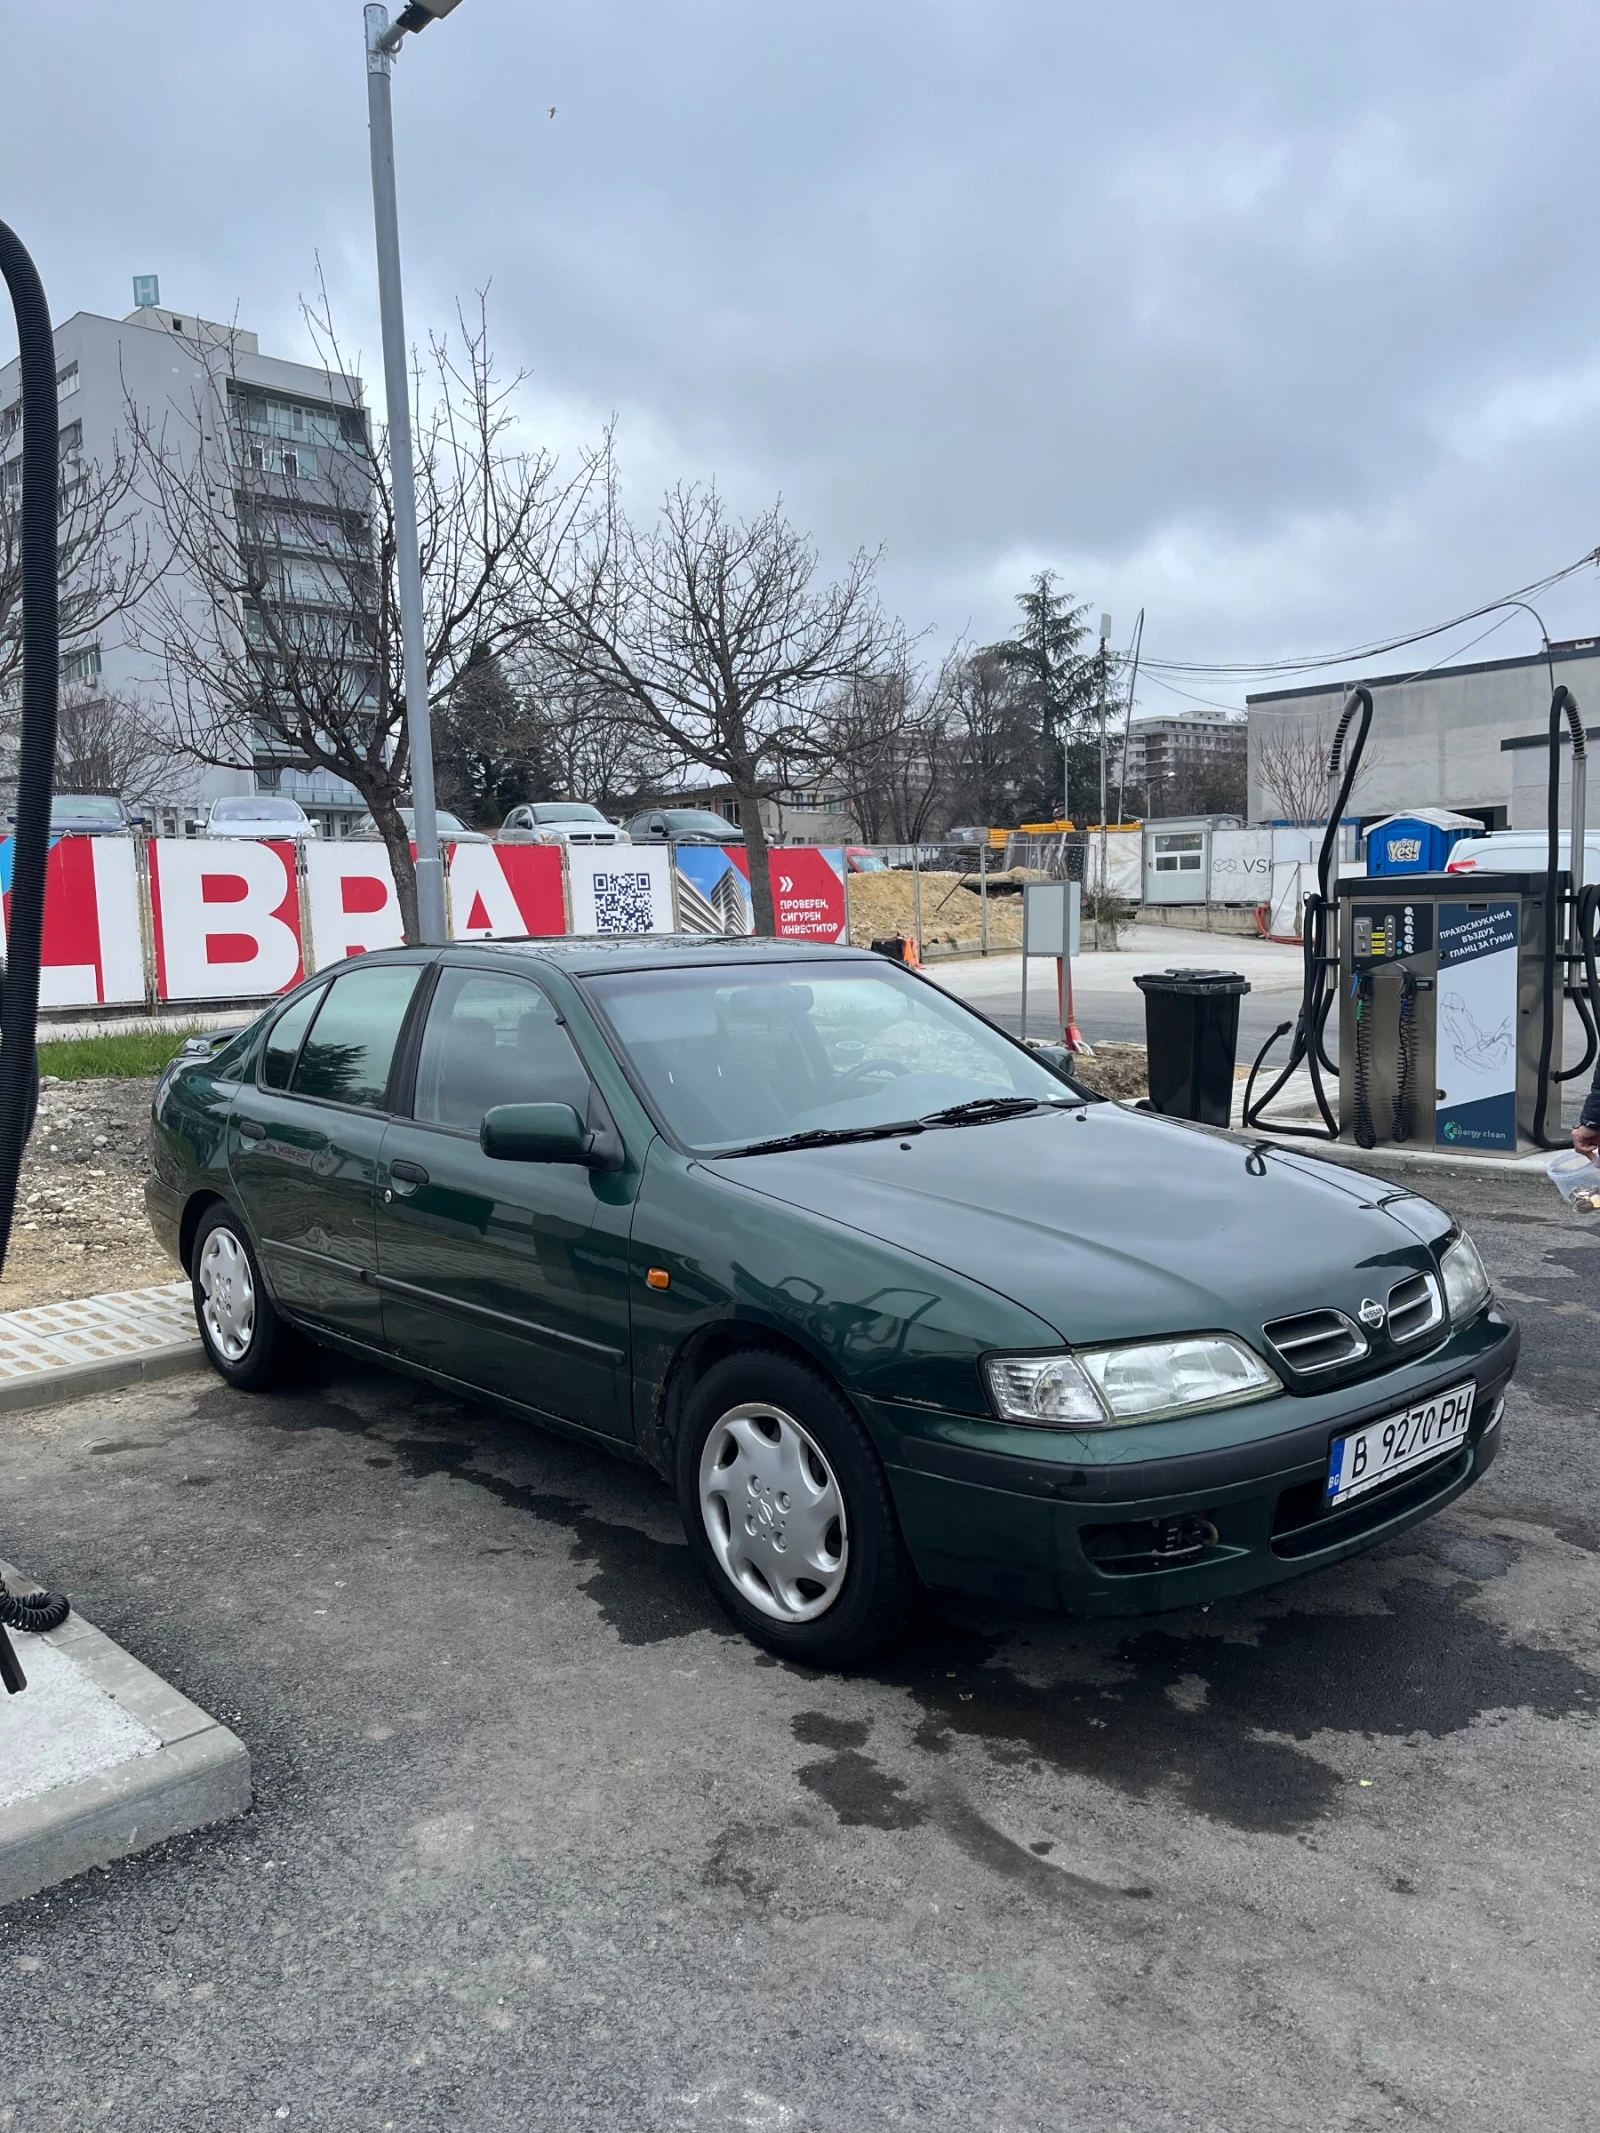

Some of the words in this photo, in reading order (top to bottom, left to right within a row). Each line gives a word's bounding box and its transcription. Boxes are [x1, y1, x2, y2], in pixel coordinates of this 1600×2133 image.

[136, 278, 156, 303] H
[780, 899, 828, 909] ПРОВЕРЕН,
[0, 837, 530, 1007] IBRA
[781, 911, 821, 922] СИГУРЕН
[1440, 910, 1512, 939] ПРАХОСМУКАЧКА
[782, 923, 838, 934] ИНВЕСТИТОР
[1461, 926, 1496, 944] ВЪЗДУХ
[1449, 943, 1479, 959] ГЛАНЦ
[1478, 940, 1490, 950] ЗА
[1489, 931, 1515, 947] ГУМИ
[1452, 1127, 1482, 1139] Energy
[1482, 1129, 1506, 1139] clean
[1351, 1435, 1368, 1479] B
[1382, 1406, 1436, 1465] 9270
[1437, 1391, 1471, 1438] PH
[1328, 1474, 1340, 1489] BG
